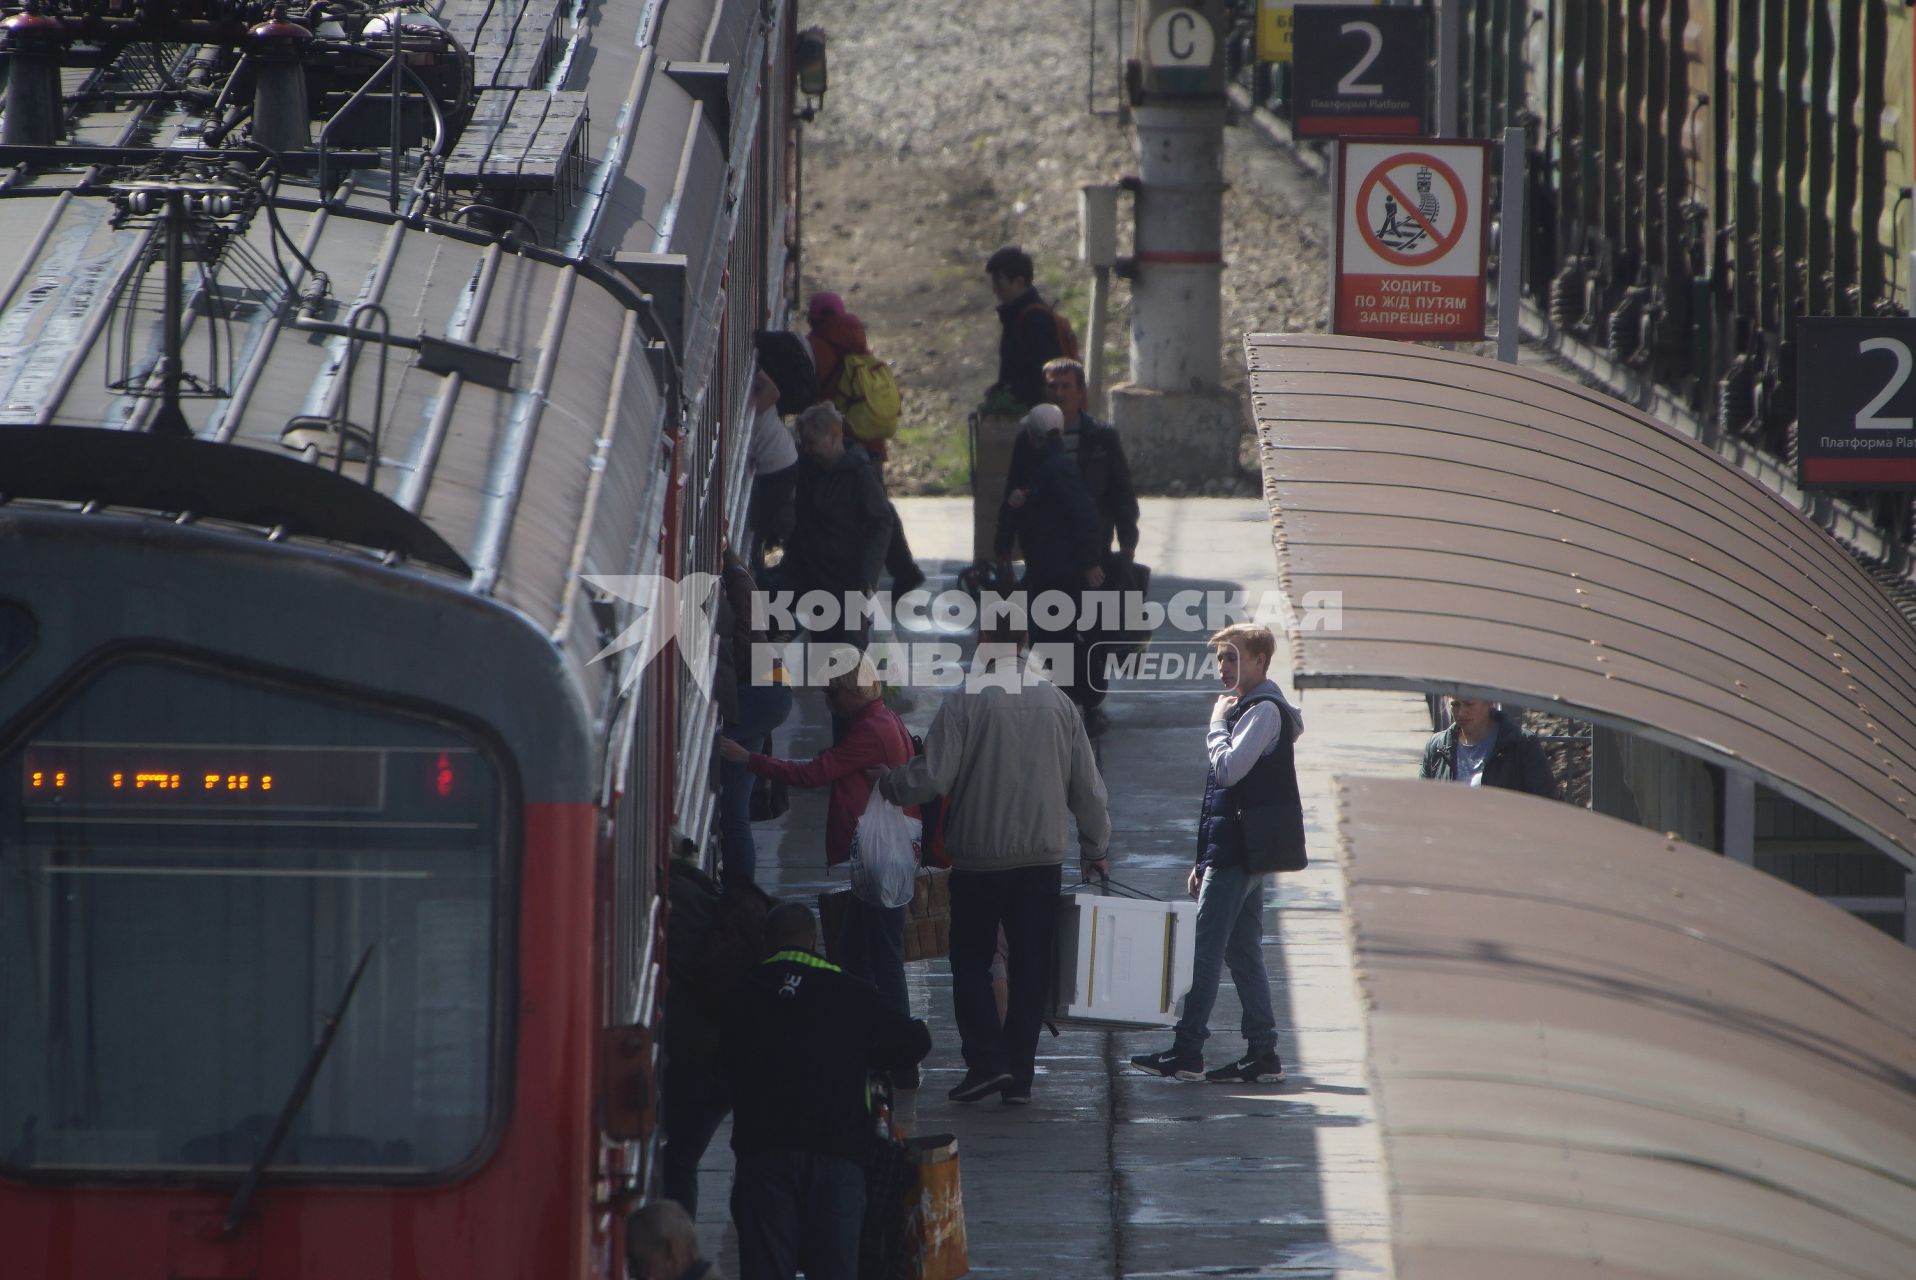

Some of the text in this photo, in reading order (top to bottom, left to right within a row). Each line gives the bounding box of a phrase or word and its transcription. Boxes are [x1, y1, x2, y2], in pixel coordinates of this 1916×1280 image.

[1337, 21, 1384, 95] 2
[1310, 98, 1411, 112] Платформа Platform
[1380, 279, 1441, 294] ХОДИТЬ
[1355, 295, 1467, 310] ПО Ж/Д ПУТЯМ
[1359, 311, 1461, 326] ЗАПРЕЩЕНО!
[1855, 337, 1914, 430] 2
[1820, 436, 1893, 450] Платформа
